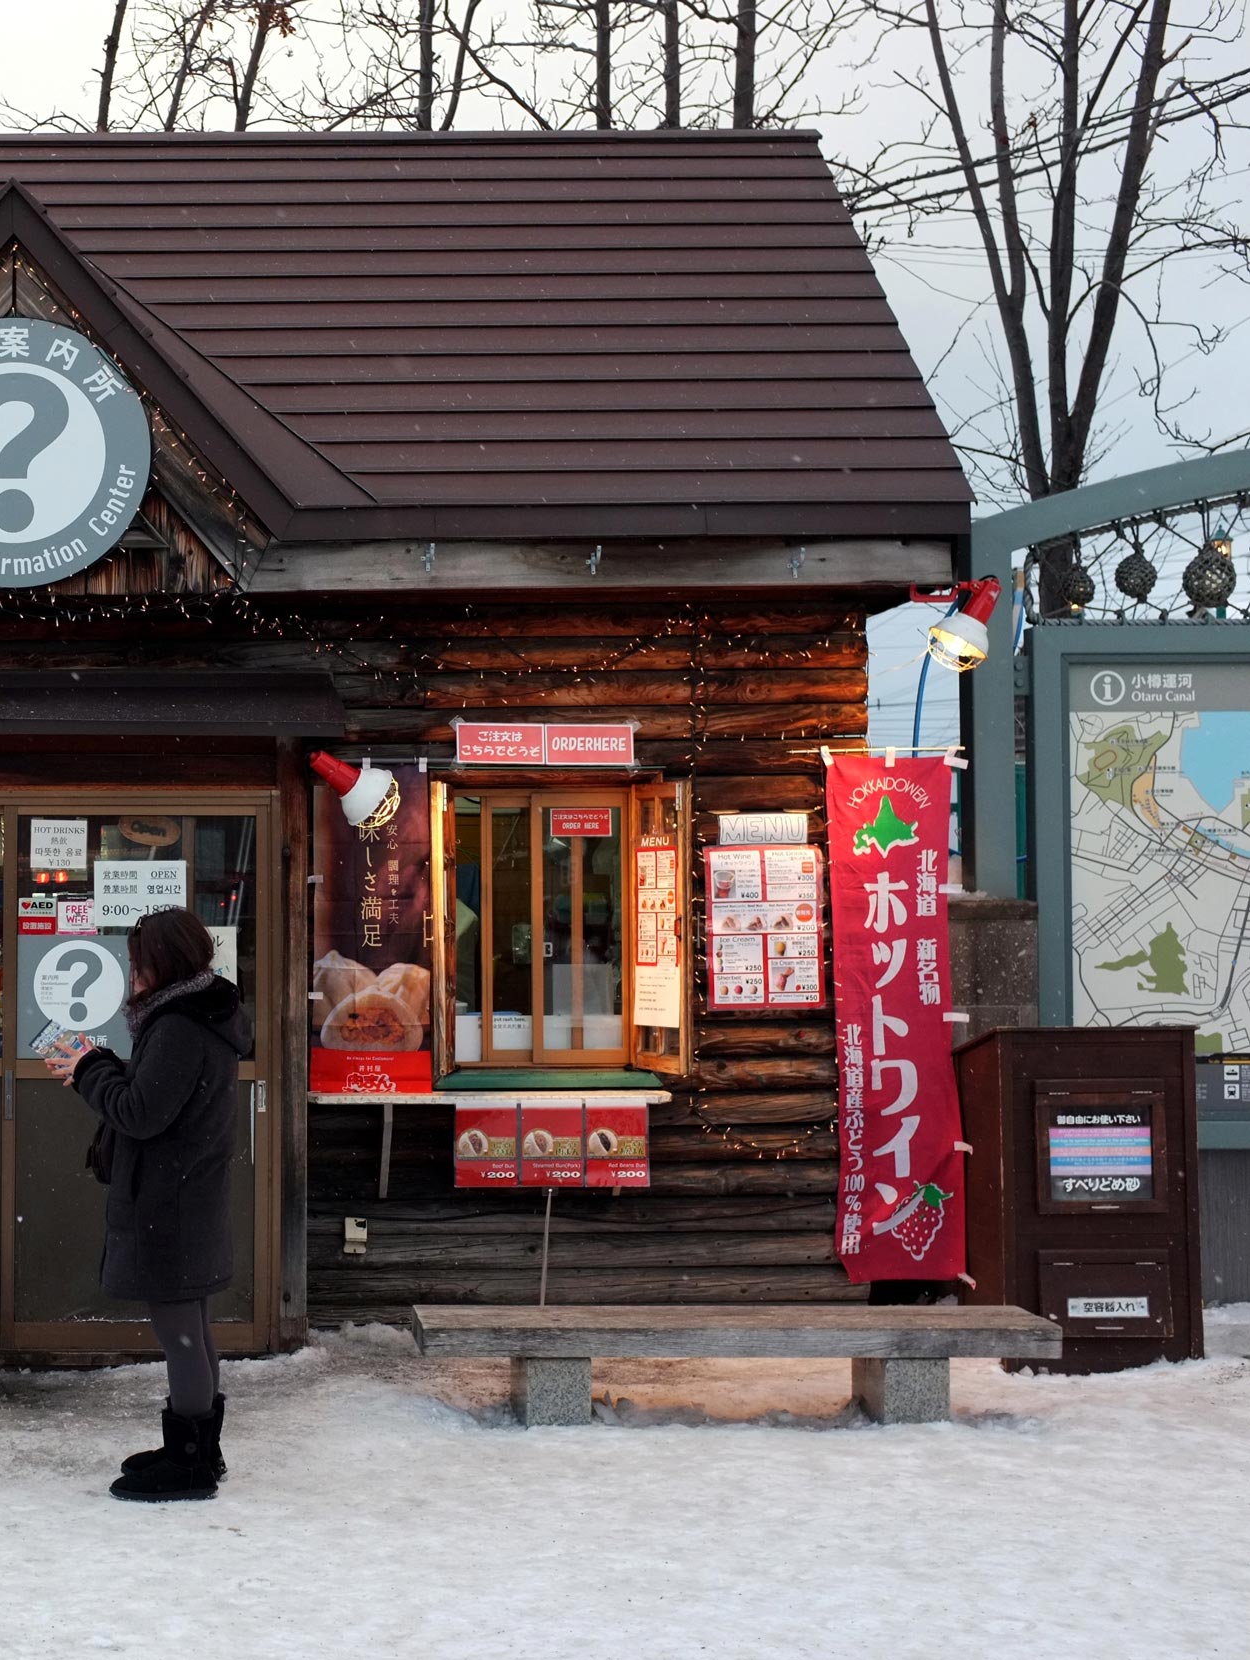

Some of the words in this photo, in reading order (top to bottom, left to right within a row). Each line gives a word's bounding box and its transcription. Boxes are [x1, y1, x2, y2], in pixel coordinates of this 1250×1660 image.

[88, 463, 136, 537] Center
[1131, 674, 1193, 688] 小樽運河
[1131, 691, 1162, 701] Otaru
[1165, 690, 1196, 702] Canal
[477, 731, 522, 742] ご注文は
[552, 737, 626, 751] ORDERHERE
[461, 745, 541, 757] こちらでどうぞ
[34, 826, 51, 834] HOT
[53, 826, 86, 834] DRINKS
[562, 822, 581, 830] ORDER
[584, 822, 600, 830] HERE
[721, 816, 803, 843] MENU
[641, 836, 669, 847] MENU
[35, 848, 60, 857] 따뜻한
[66, 848, 82, 857] 음료
[103, 870, 138, 879] 営業時間
[151, 870, 178, 879] OPEN
[916, 849, 938, 917] 北海道
[147, 884, 182, 895] 영업시간
[65, 904, 88, 914] FREE
[916, 937, 941, 1005] 新名物
[863, 871, 924, 1235] ホットワイン
[1057, 1115, 1141, 1125] 御自由にお使い下さい
[1063, 1177, 1140, 1192] すべりどめ砂
[1083, 1303, 1136, 1312] 空容器入れ
